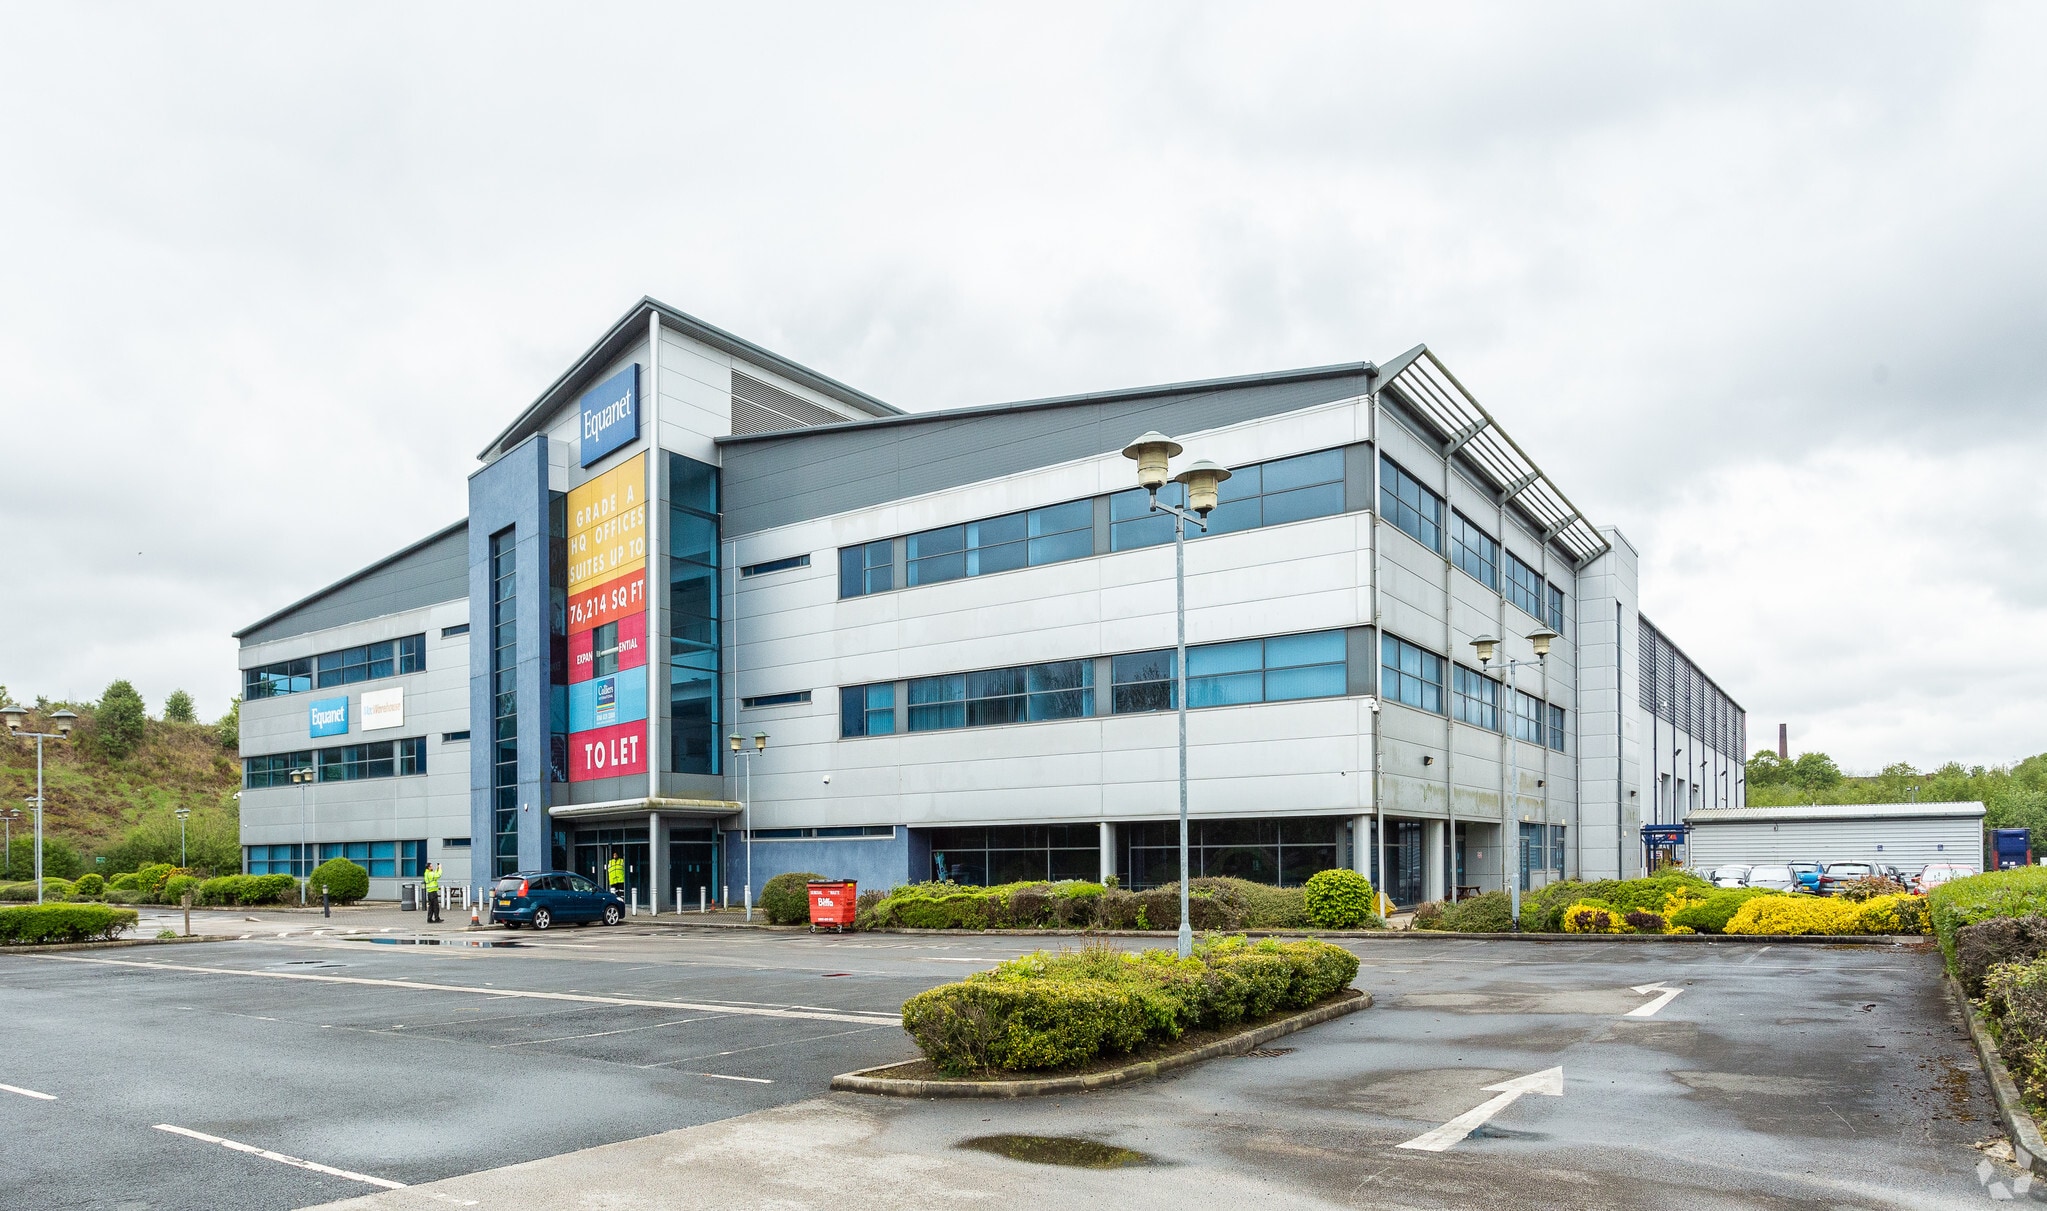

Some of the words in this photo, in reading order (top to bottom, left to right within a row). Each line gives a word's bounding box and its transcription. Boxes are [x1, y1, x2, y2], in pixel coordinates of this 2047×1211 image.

[583, 388, 632, 442] Equanet
[576, 493, 616, 528] GRADE
[626, 485, 634, 505] A
[571, 533, 587, 556] HQ
[595, 506, 644, 545] OFFICES
[569, 553, 605, 584] SUITES
[609, 545, 624, 567] UP
[629, 537, 644, 559] TO
[570, 594, 607, 624] 76,214
[611, 588, 627, 610] SQ
[631, 579, 644, 602] FT
[311, 705, 345, 729] Equanet
[585, 741, 606, 770] TO
[611, 735, 639, 766] LET
